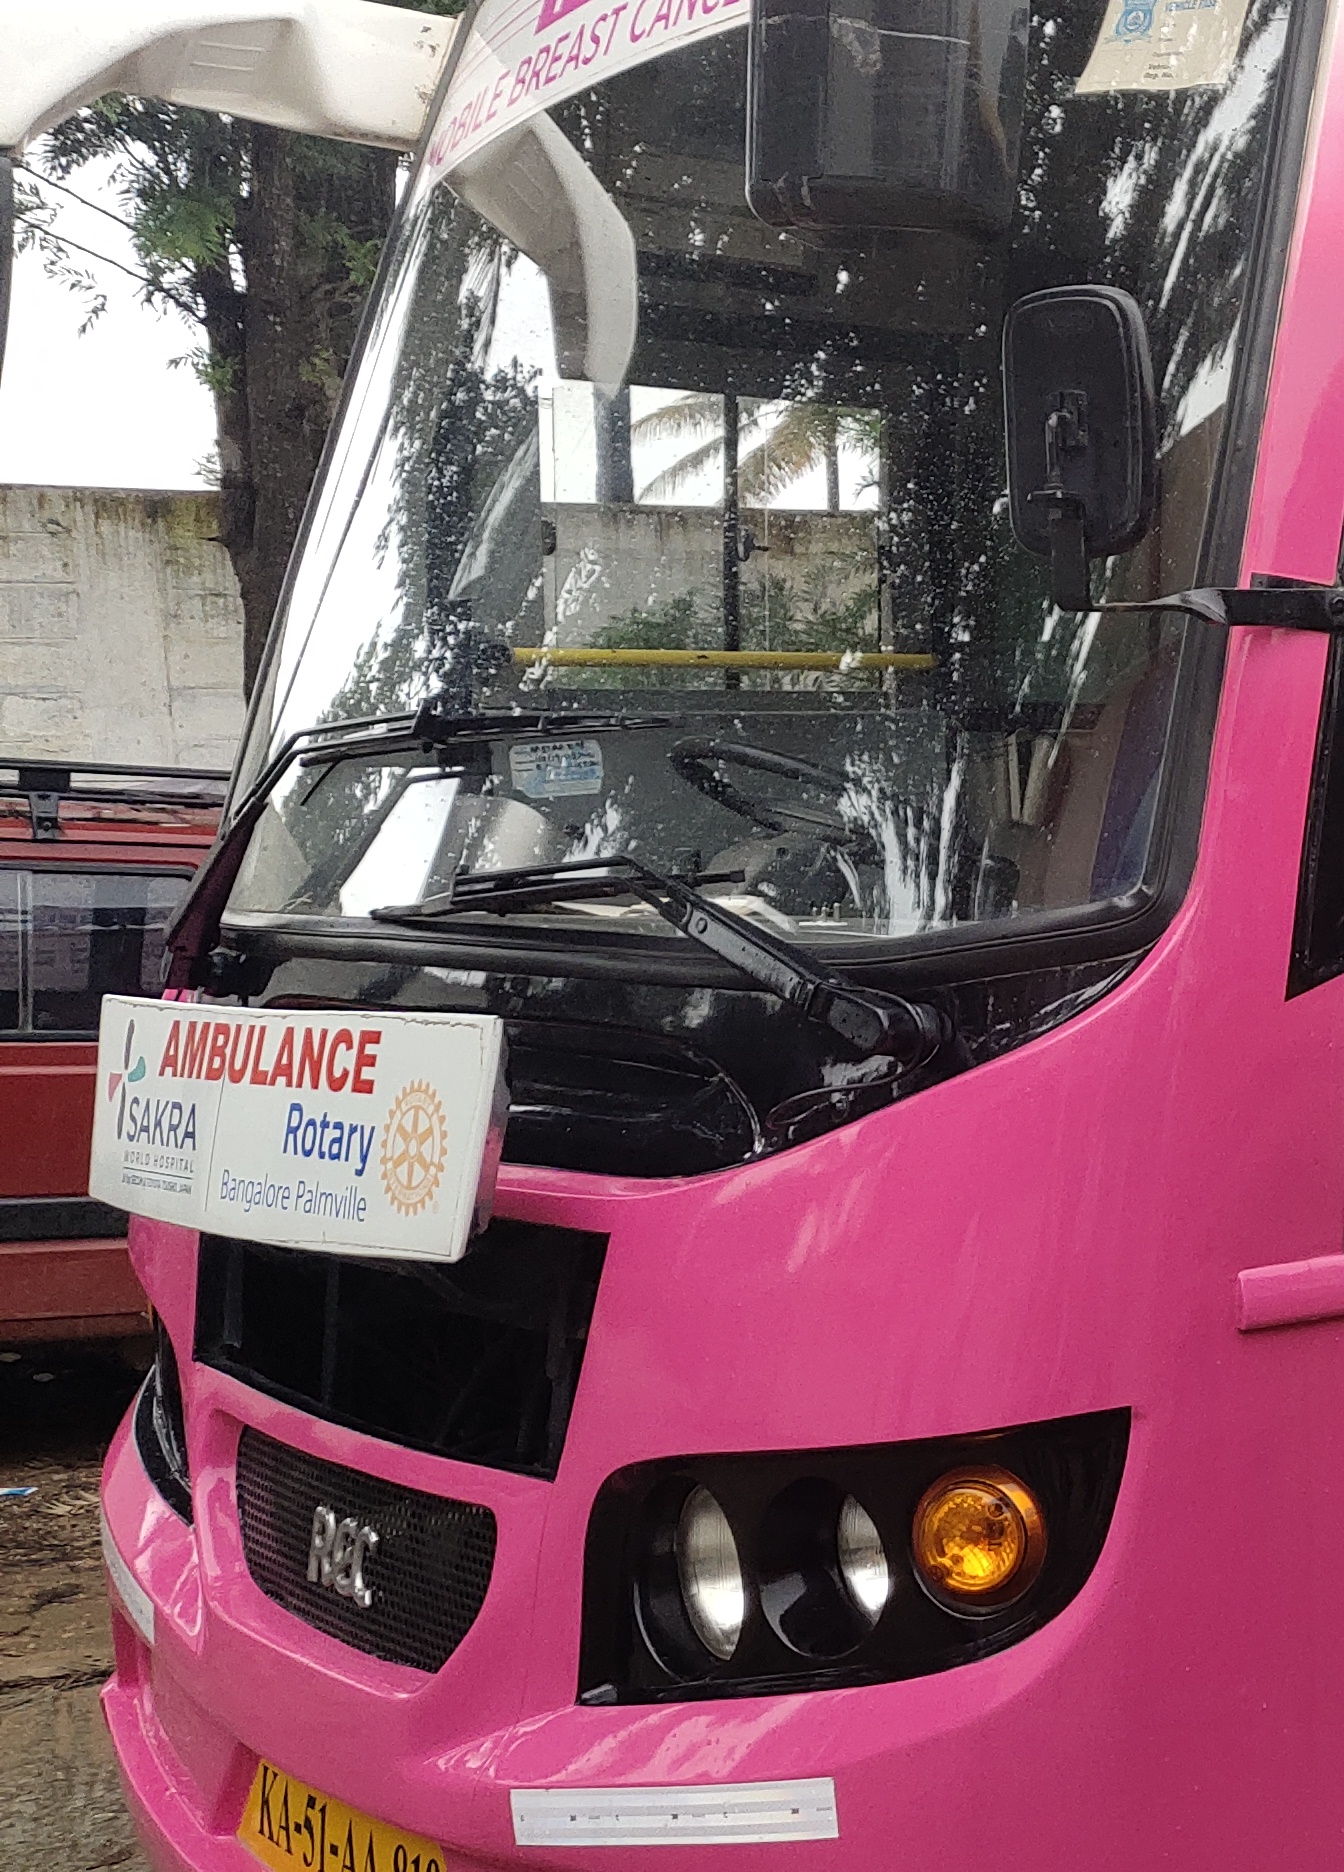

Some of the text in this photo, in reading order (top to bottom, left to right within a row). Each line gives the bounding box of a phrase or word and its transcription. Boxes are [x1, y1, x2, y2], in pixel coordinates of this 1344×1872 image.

[506, 4, 628, 108] BREAST
[158, 1019, 383, 1095] AMBULANCE
[126, 1096, 197, 1151] SAKRA
[283, 1103, 375, 1177] Rotary
[123, 1149, 194, 1174] WORLD HOSPITAL
[220, 1169, 290, 1212] Bangalore
[294, 1179, 367, 1223] Palmville
[307, 1506, 379, 1608] REC
